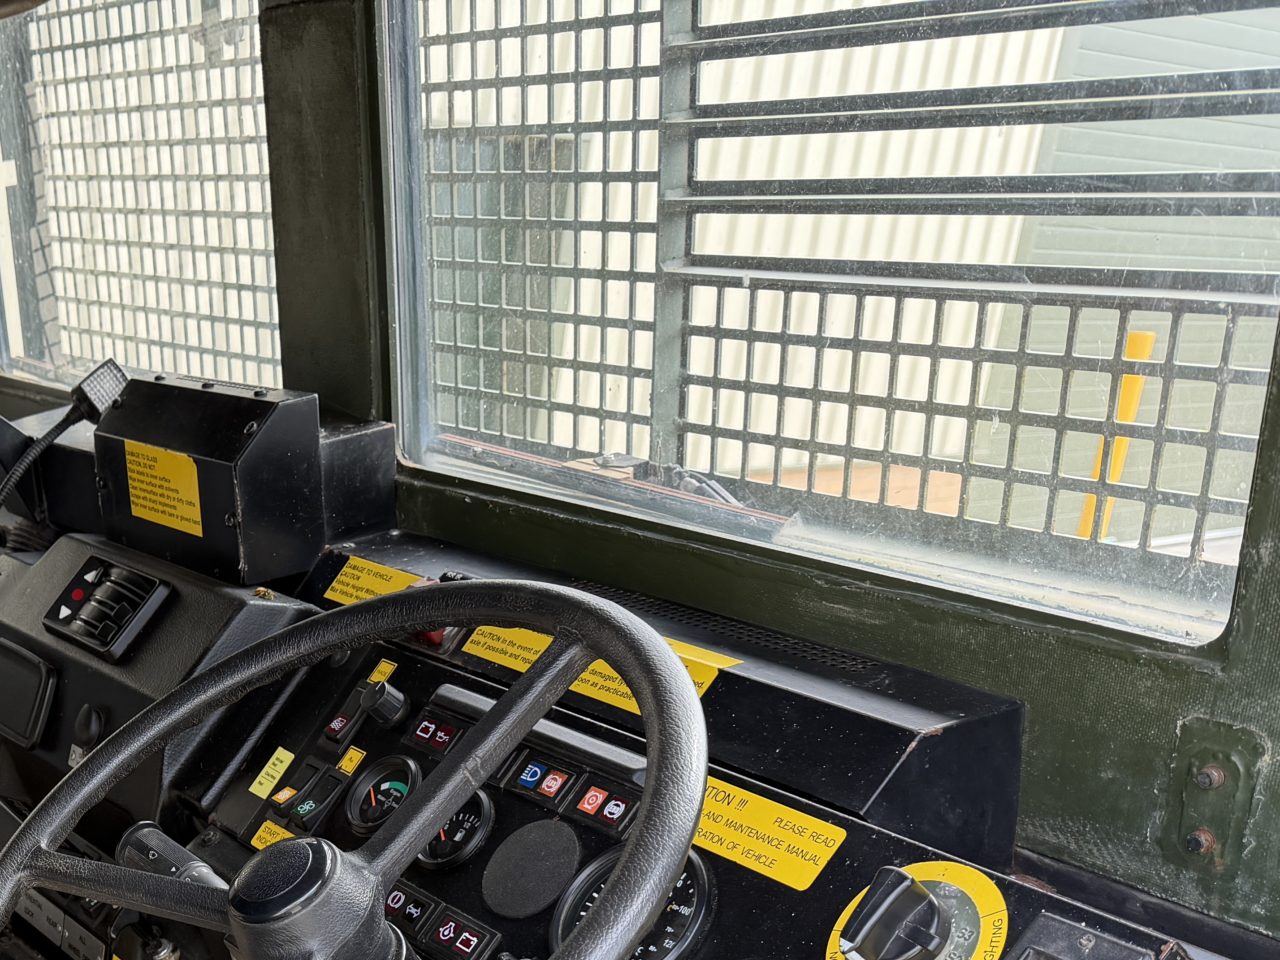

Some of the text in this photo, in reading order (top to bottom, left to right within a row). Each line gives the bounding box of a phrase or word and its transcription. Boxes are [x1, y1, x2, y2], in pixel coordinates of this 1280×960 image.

[340, 570, 361, 581] CAUTION
[345, 562, 366, 574] DAMAGE
[372, 571, 393, 583] VEHICLE
[470, 639, 482, 647] axle
[485, 643, 509, 657] possible
[508, 651, 520, 660] and
[476, 629, 502, 642] CAUTION
[507, 639, 516, 648] the
[516, 644, 533, 654] event
[589, 667, 618, 684] damaged
[590, 681, 598, 689] as
[262, 825, 281, 839] START
[723, 818, 785, 850] MAINTENANCE
[784, 844, 823, 866] MANUAL
[773, 816, 836, 849] PLEASE READ
[726, 841, 741, 852] OF
[740, 846, 777, 869] VEHICLE
